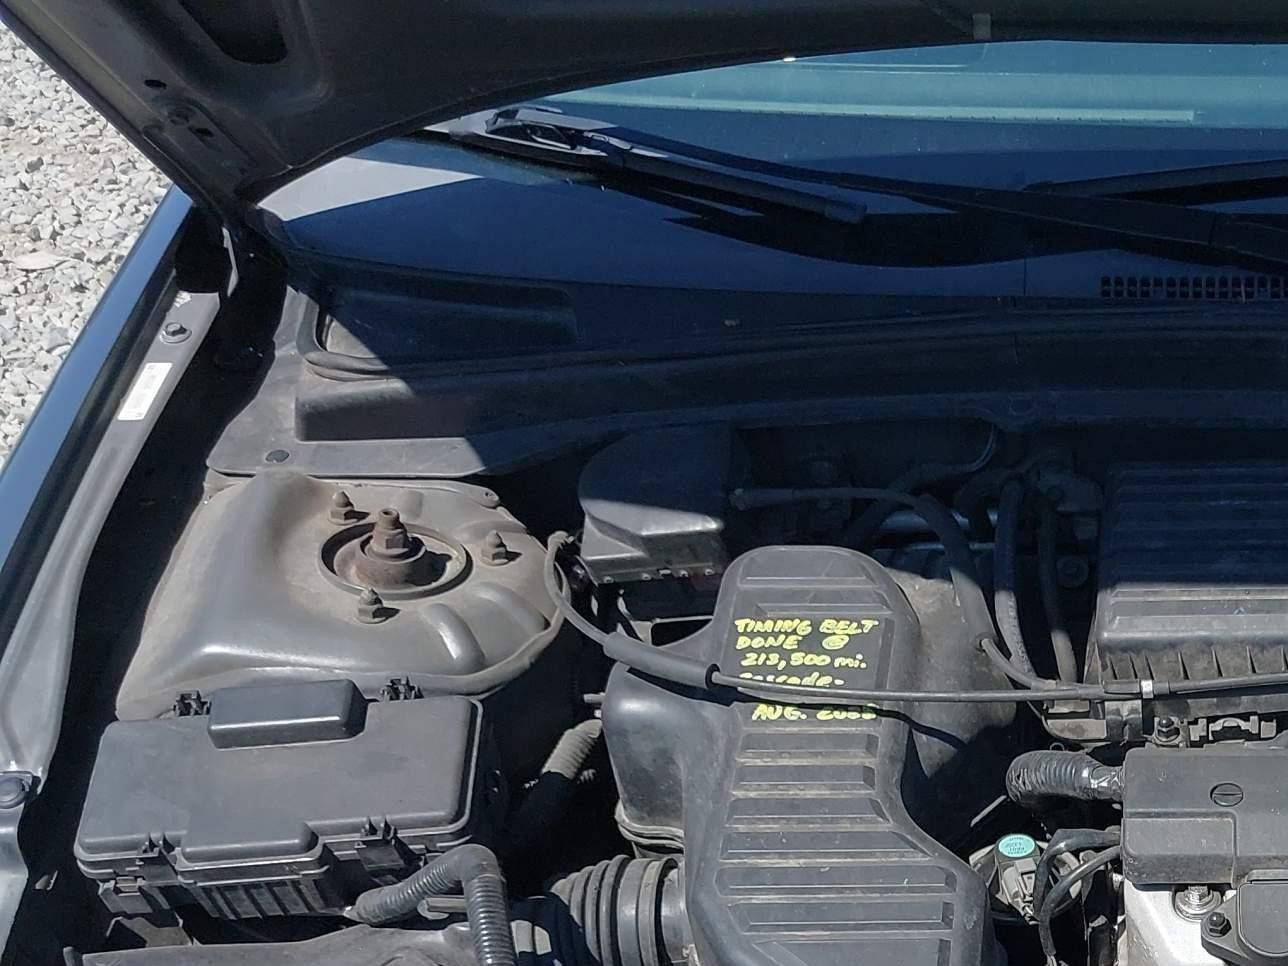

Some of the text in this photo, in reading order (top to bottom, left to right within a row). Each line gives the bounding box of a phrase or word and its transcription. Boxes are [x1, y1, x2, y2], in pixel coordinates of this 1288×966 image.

[735, 618, 879, 635] TIMING BELT
[736, 634, 803, 650] DONE
[740, 652, 867, 670] 213,500 mi.
[752, 703, 807, 721] AUG.
